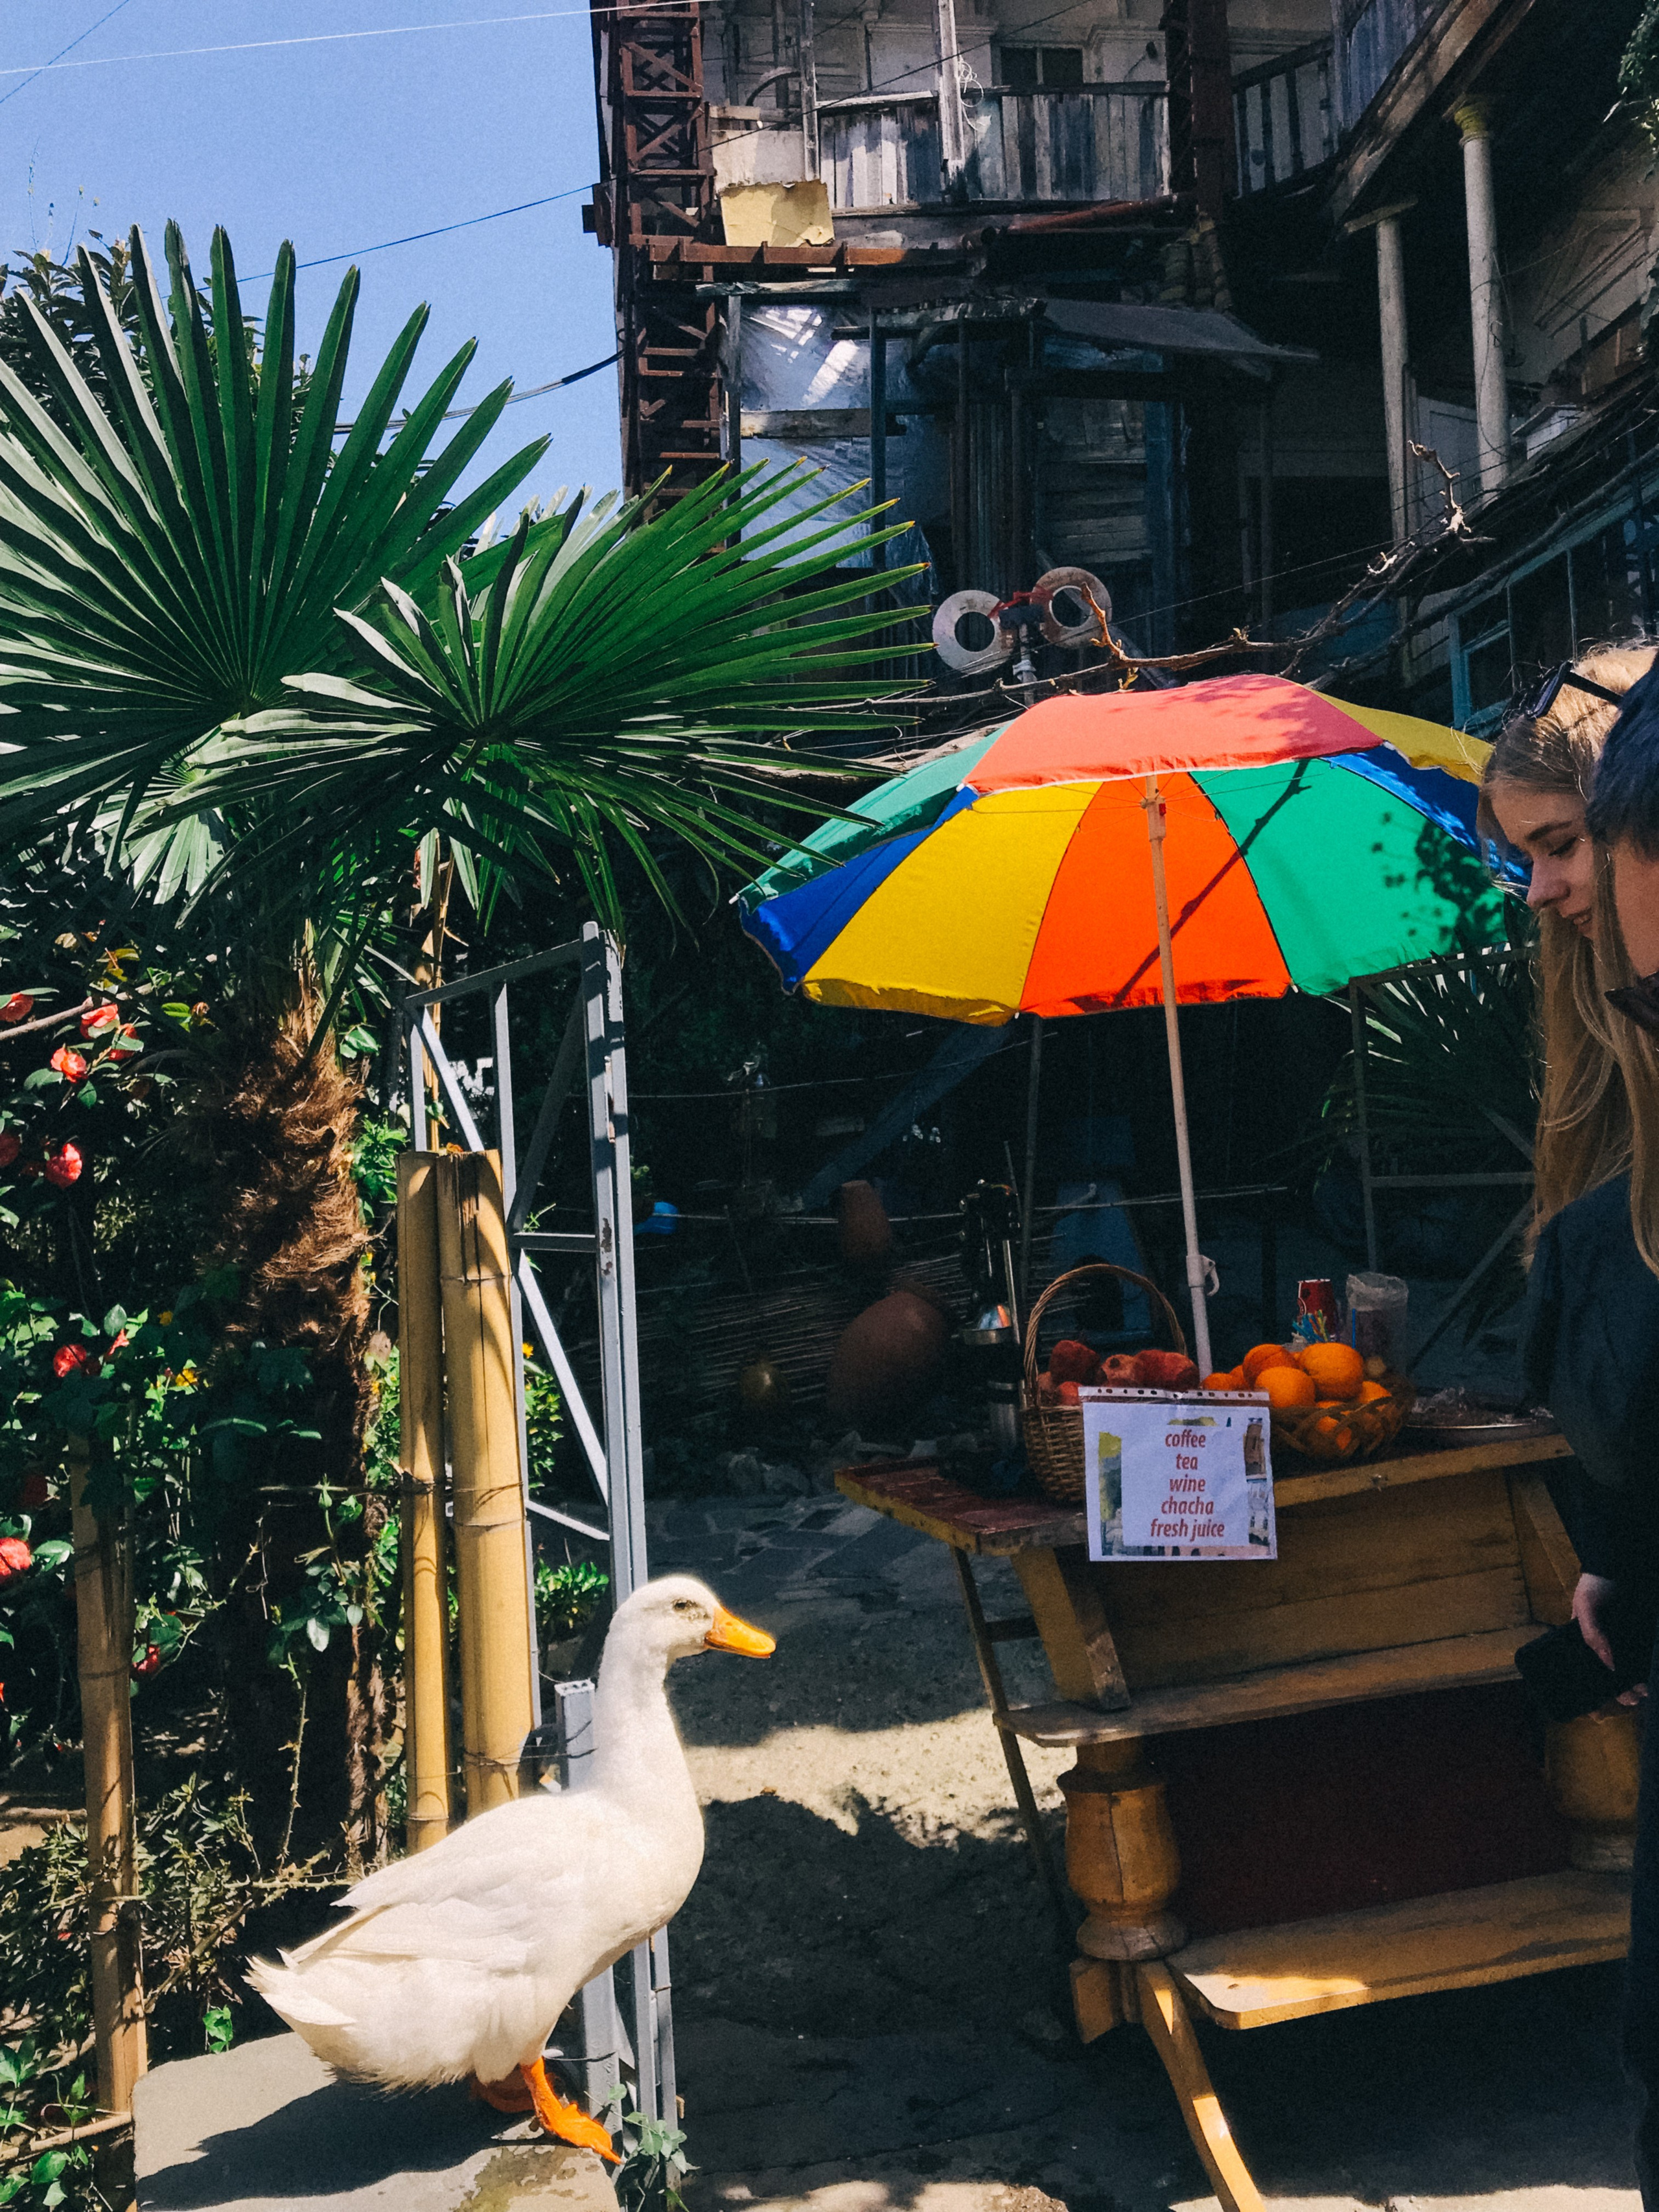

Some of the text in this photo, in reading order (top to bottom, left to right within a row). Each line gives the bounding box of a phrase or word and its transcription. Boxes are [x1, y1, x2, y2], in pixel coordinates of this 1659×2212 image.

[1165, 1429, 1206, 1447] coffee
[1176, 1454, 1198, 1470] tea
[1169, 1474, 1206, 1492] wine
[1161, 1496, 1214, 1515] chacha
[1150, 1519, 1225, 1542] fresh juice
